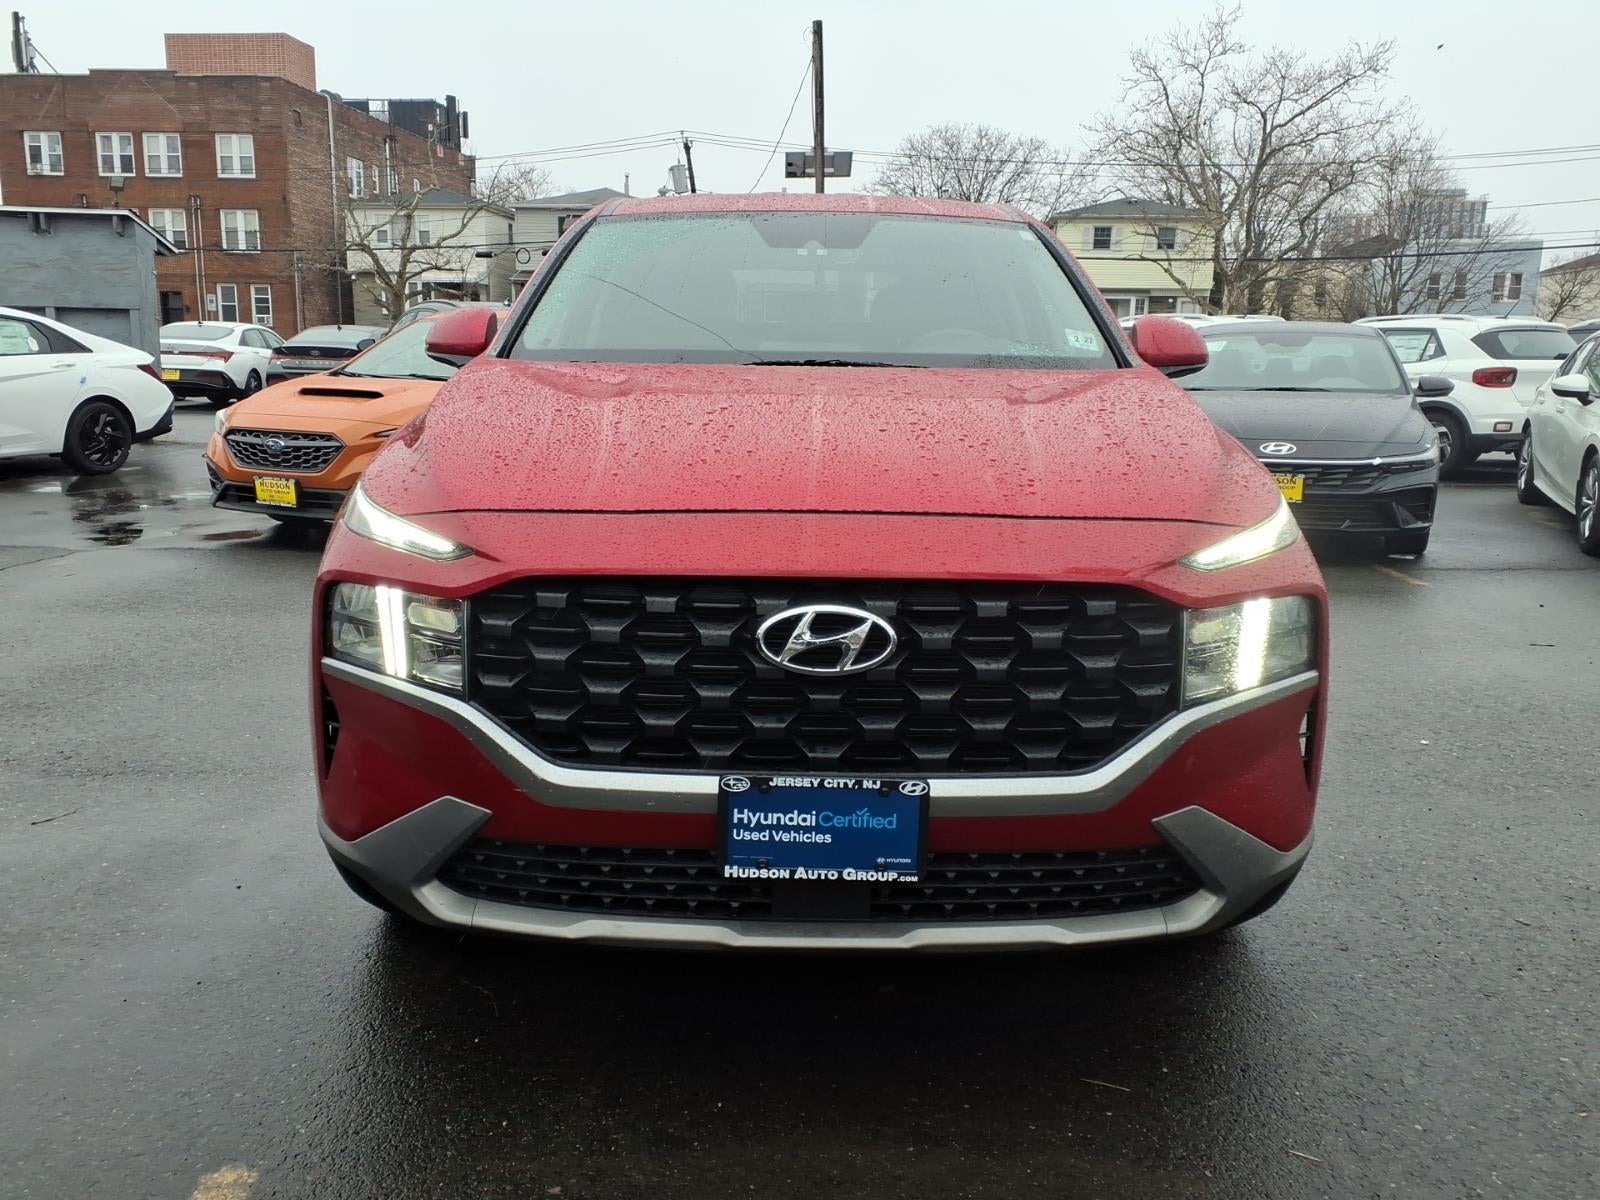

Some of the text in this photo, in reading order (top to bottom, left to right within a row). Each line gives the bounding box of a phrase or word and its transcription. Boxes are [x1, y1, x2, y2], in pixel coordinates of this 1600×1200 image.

[259, 480, 291, 490] HUDSON
[769, 776, 881, 790] JERSEY CITY, NJ
[733, 808, 897, 829] Hyundai Certified
[733, 829, 832, 844] Used Vehicles
[724, 865, 790, 879] HUDSON
[794, 866, 839, 881] AUTO
